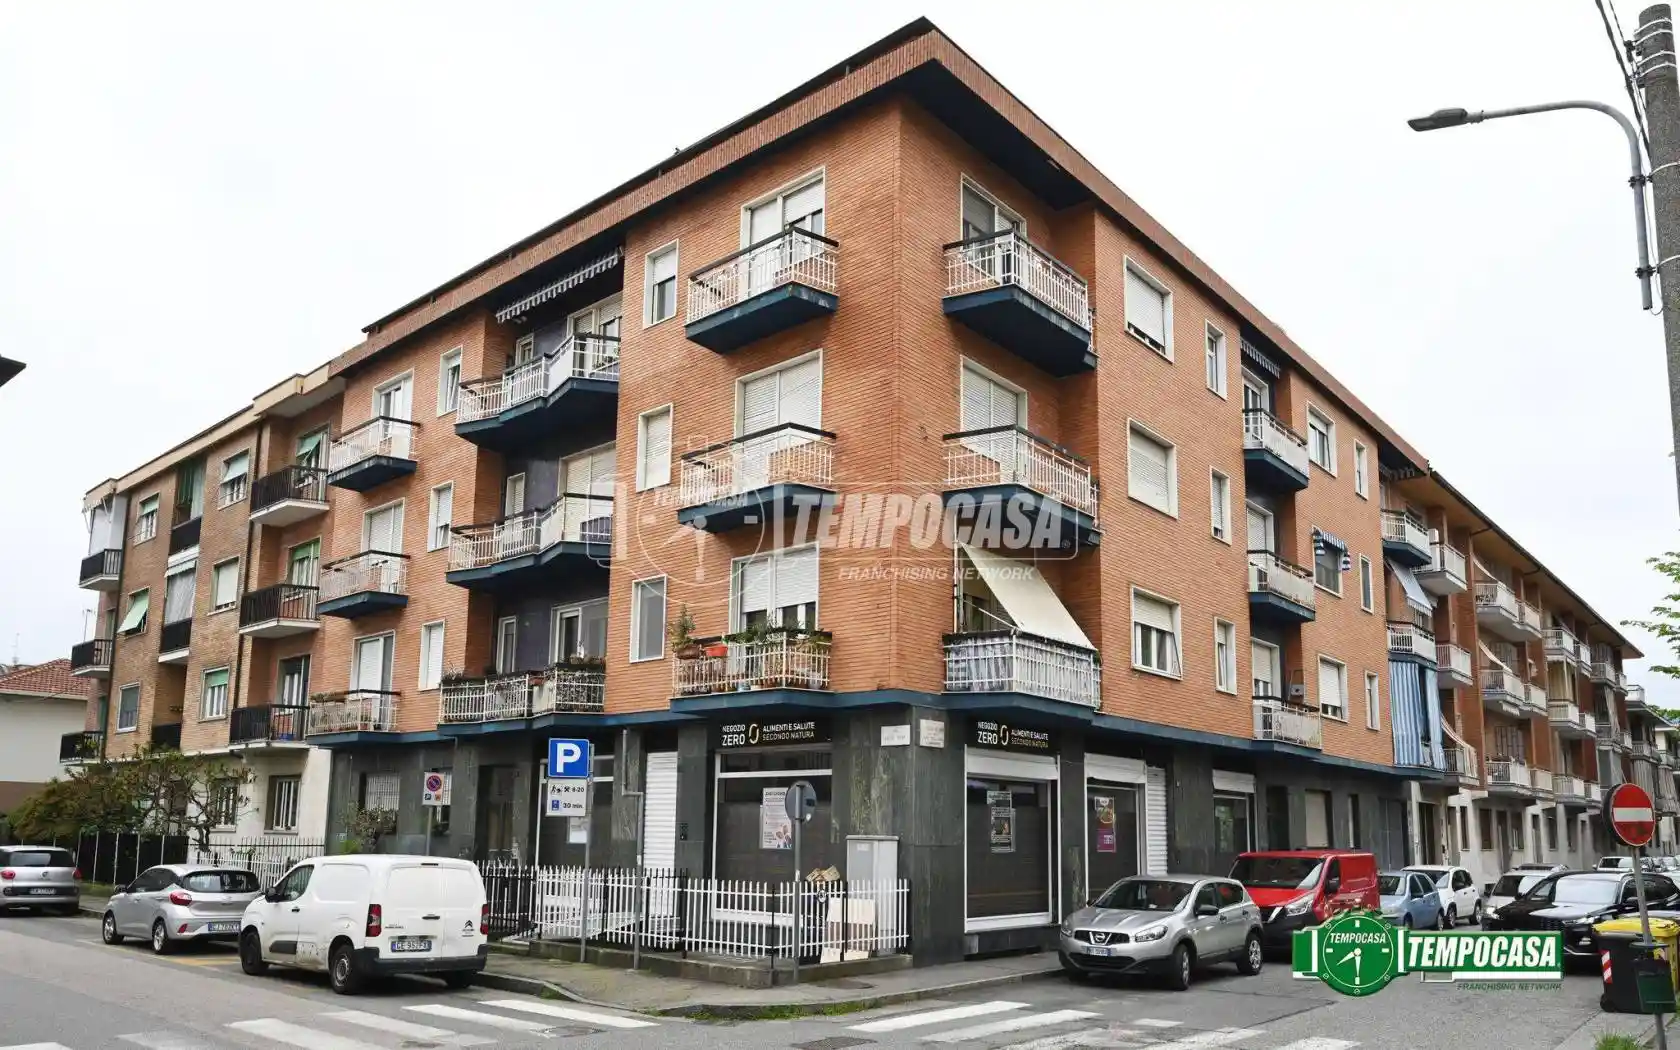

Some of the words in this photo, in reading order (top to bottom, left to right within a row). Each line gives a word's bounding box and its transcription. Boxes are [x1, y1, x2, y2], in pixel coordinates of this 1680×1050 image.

[722, 724, 746, 733] NEGOZIO
[763, 724, 788, 732] ALIMENTI
[793, 722, 815, 730] SALUTE
[977, 721, 998, 731] NEGOZIO
[722, 734, 746, 746] ZERO
[762, 732, 789, 741] SECONDO
[790, 731, 815, 740] NATURA
[977, 731, 998, 745] ZERO
[1034, 732, 1048, 740] SALUTE
[556, 743, 582, 773] P
